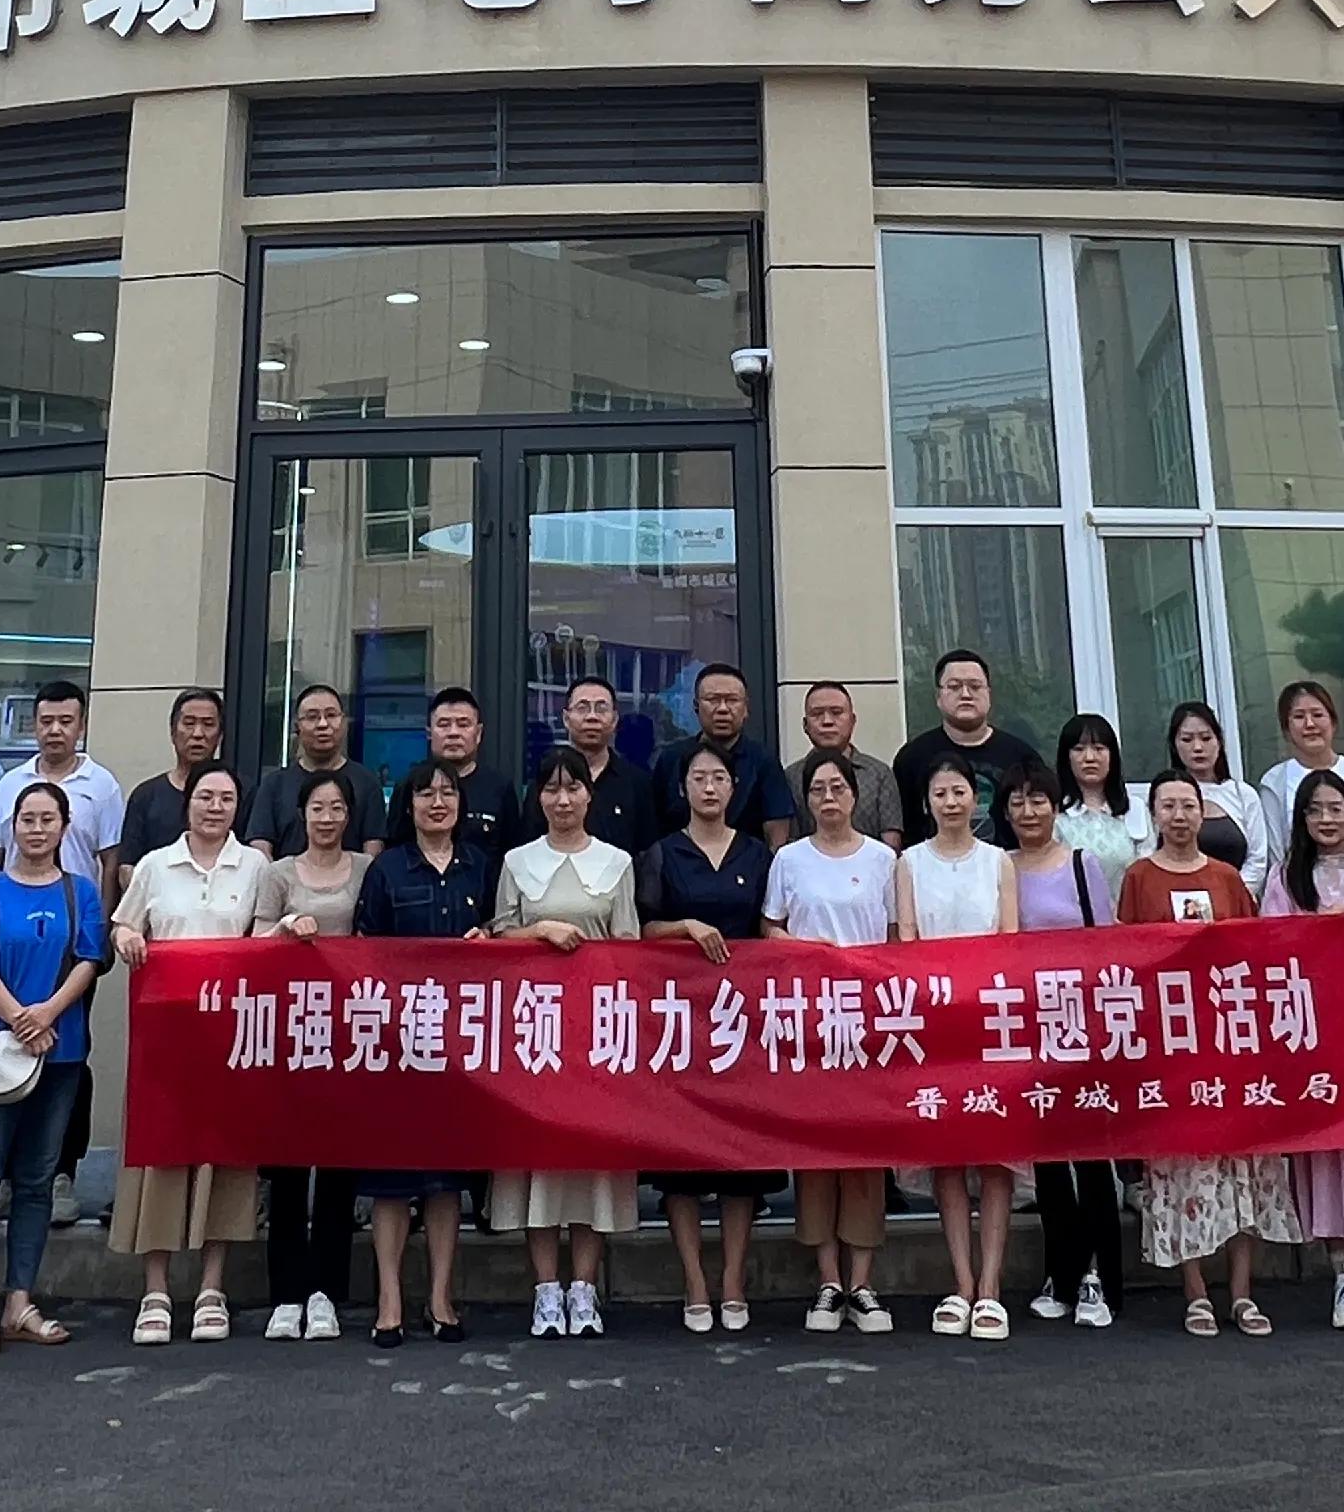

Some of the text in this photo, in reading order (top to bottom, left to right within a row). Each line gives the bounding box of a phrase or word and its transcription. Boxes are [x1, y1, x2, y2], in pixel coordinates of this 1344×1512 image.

[198, 957, 1320, 1074] “加强党建引领 助力乡村振兴” 主题党日活动
[906, 1072, 1340, 1120] 晋城市城区财政局
